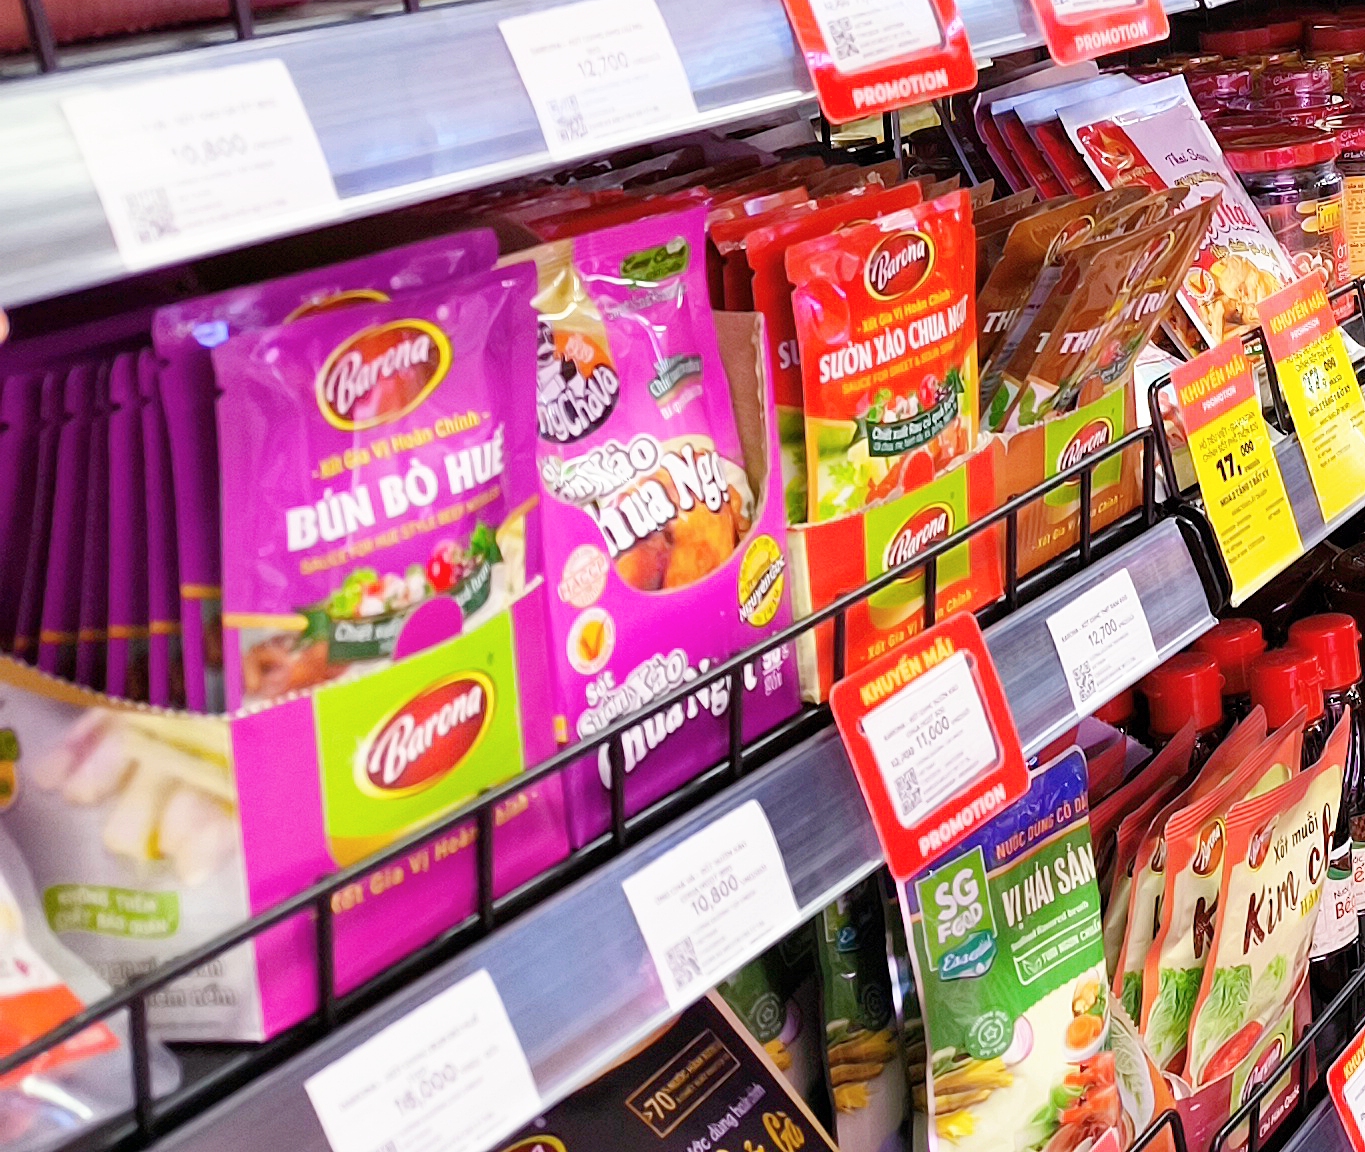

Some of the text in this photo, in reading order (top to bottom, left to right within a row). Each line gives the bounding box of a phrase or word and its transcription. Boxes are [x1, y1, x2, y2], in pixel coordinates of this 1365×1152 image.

[1073, 19, 1149, 53] PROMOTION
[851, 68, 950, 110] PROMOTION
[871, 240, 926, 291] Barona
[326, 333, 431, 415] Barona
[818, 339, 874, 384] SƯỜN
[874, 323, 907, 367] XÀO
[908, 314, 947, 351] CHUA
[1180, 353, 1246, 406] KHUYẾN MÃI
[1201, 385, 1238, 414] PROMOTION
[434, 410, 481, 440] Chỉnh
[286, 483, 376, 552] BÚN
[379, 457, 439, 520] BÒ
[660, 444, 730, 513] Ngọ
[889, 508, 948, 568] Barona
[1087, 617, 1119, 649] 12,700
[859, 636, 957, 708] KHUYẾN MÃI
[368, 679, 485, 786] Barona
[914, 715, 951, 751] 11,000
[918, 782, 1007, 858] PROMOTION
[1271, 810, 1319, 866] Xốt muối
[367, 865, 405, 898] Gia
[409, 848, 432, 879] Vị
[691, 873, 740, 917] 10,800
[933, 868, 980, 923] SG
[1001, 842, 1097, 932] VỊ HẢI SẢN
[1242, 802, 1333, 955] Kim ch
[937, 905, 984, 944] FOOD
